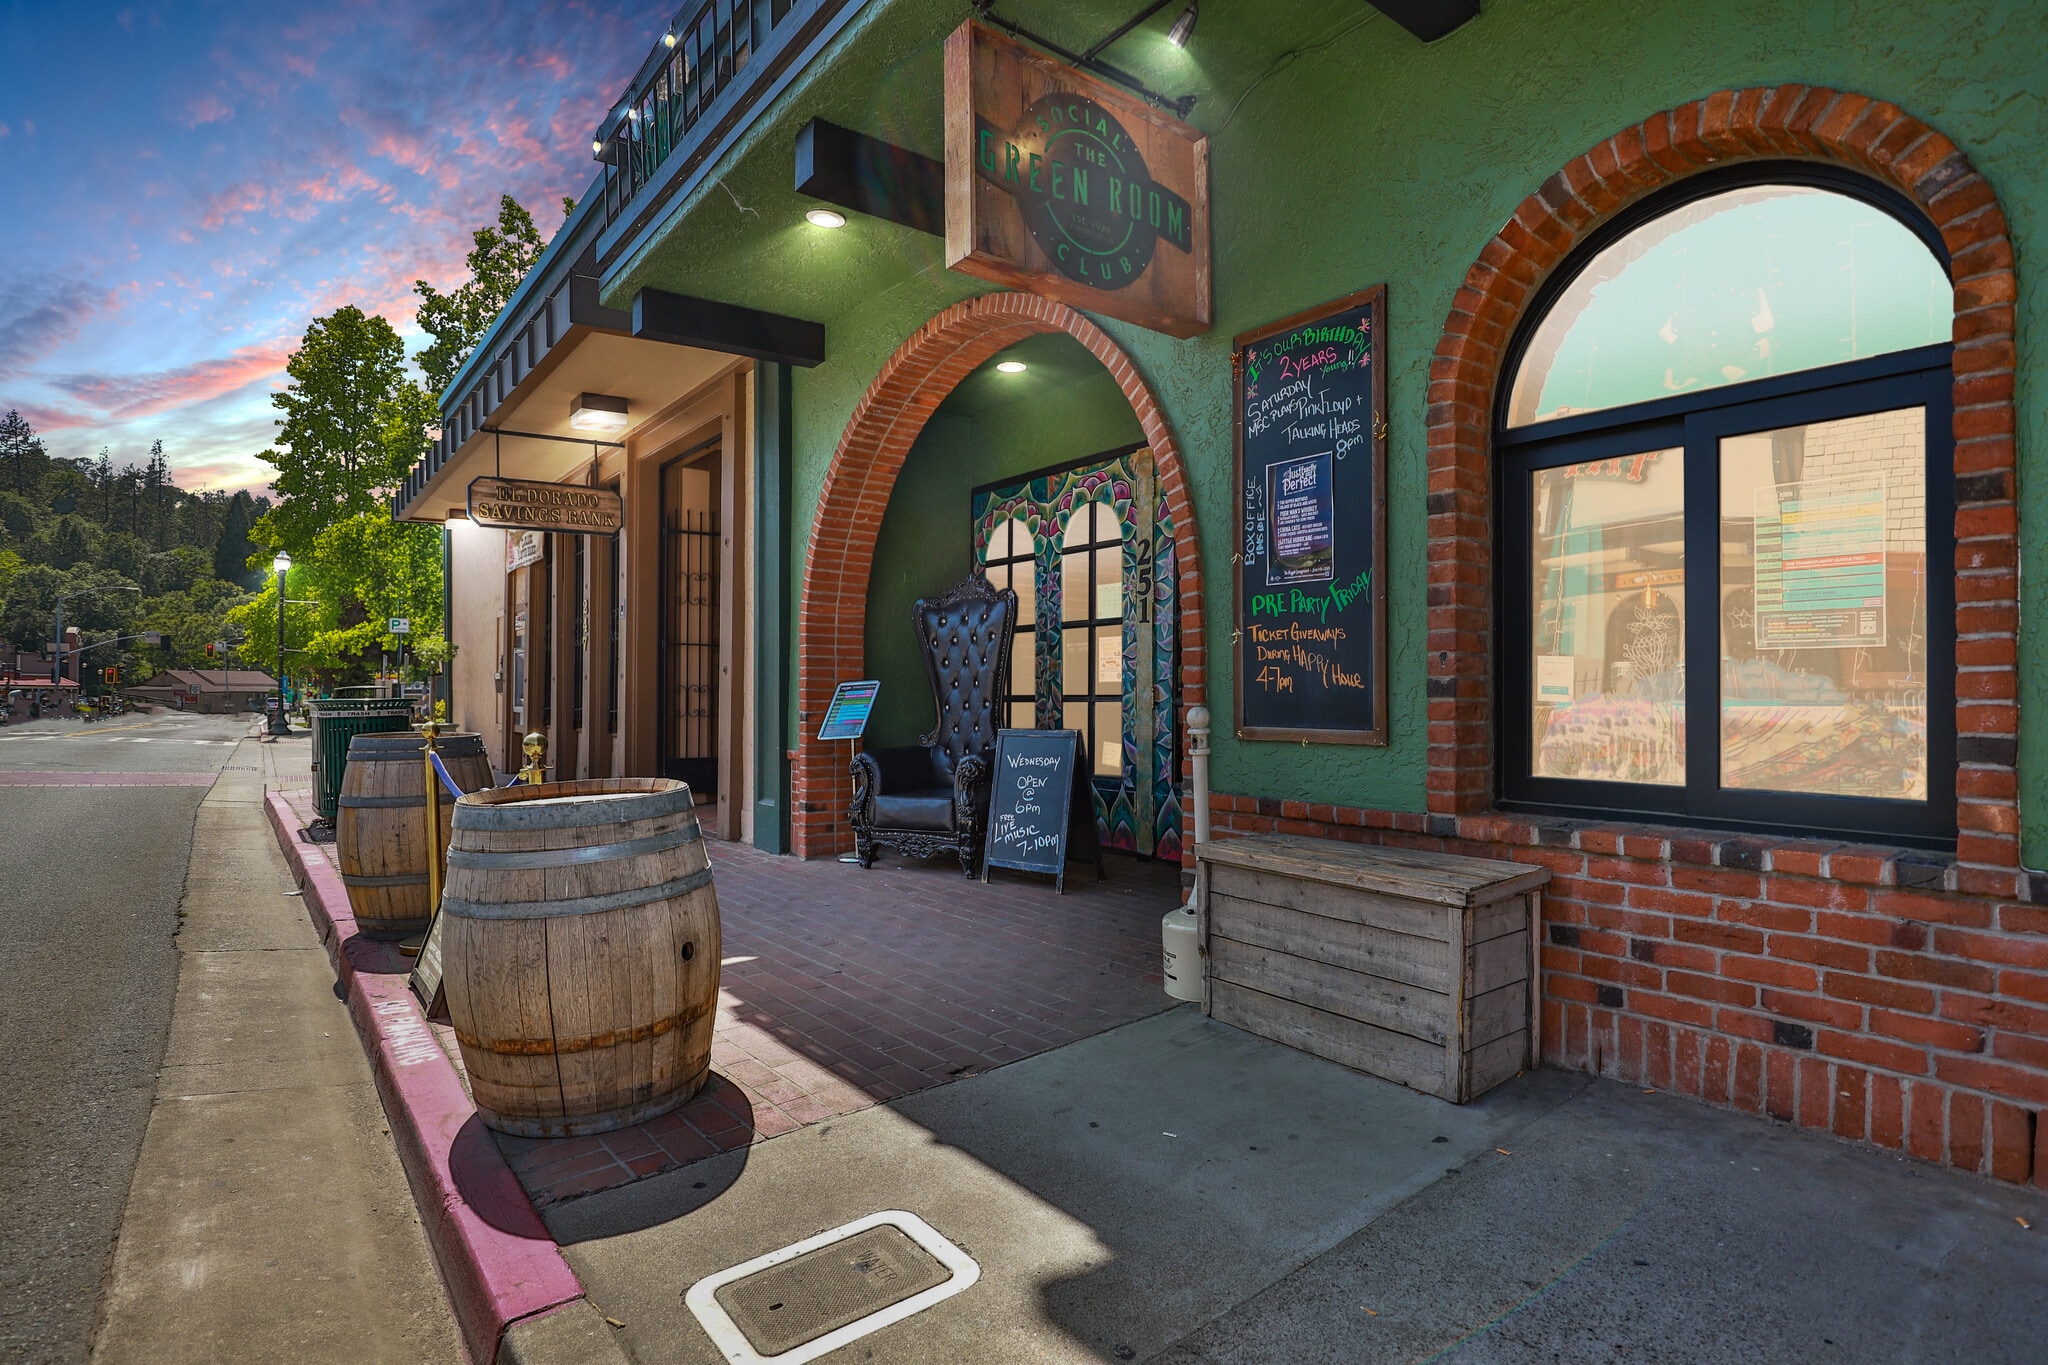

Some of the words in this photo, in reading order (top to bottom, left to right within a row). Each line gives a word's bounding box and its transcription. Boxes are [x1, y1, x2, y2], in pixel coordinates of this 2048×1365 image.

[1036, 104, 1121, 151] SOCIAL
[1074, 142, 1106, 168] THE
[980, 128, 1089, 206] GREEN
[1109, 176, 1184, 242] ROOM
[1056, 243, 1133, 280] CLUB
[1246, 348, 1273, 386] IT'S
[1273, 333, 1302, 356] OUR
[1303, 325, 1371, 368] BIRTHDAY
[1280, 355, 1294, 380] 2
[1292, 346, 1337, 378] YEARS
[1247, 374, 1313, 422] SATURDAY
[1270, 400, 1300, 421] PLAYS
[1318, 388, 1351, 415] FLOYD
[1281, 420, 1327, 445] TALKING
[1329, 417, 1361, 439] HEADS
[495, 485, 521, 502] EL
[526, 488, 600, 508] DORADO
[1245, 475, 1256, 532] OFFICE
[478, 502, 562, 524] SAVINGS
[567, 510, 616, 527] BANK
[1244, 533, 1255, 566] BOX
[1137, 538, 1152, 623] 251
[1252, 592, 1287, 618] PRE
[1289, 588, 1330, 624] PARTY
[1327, 567, 1373, 612] FRIDAY
[1247, 623, 1289, 643] TICKET
[1290, 621, 1346, 650] GIVEAWAYS
[1292, 644, 1330, 689] HAPPY
[1331, 663, 1365, 689] HOUR
[1006, 752, 1061, 771] WEDNESDAY
[1016, 774, 1048, 790] OPEN
[1022, 787, 1035, 801] @
[994, 819, 1017, 844] LIVE
[1000, 813, 1016, 822] FREE
[371, 999, 412, 1015] NO
[380, 1016, 440, 1066] PARKING
[857, 1250, 899, 1284] WATER
